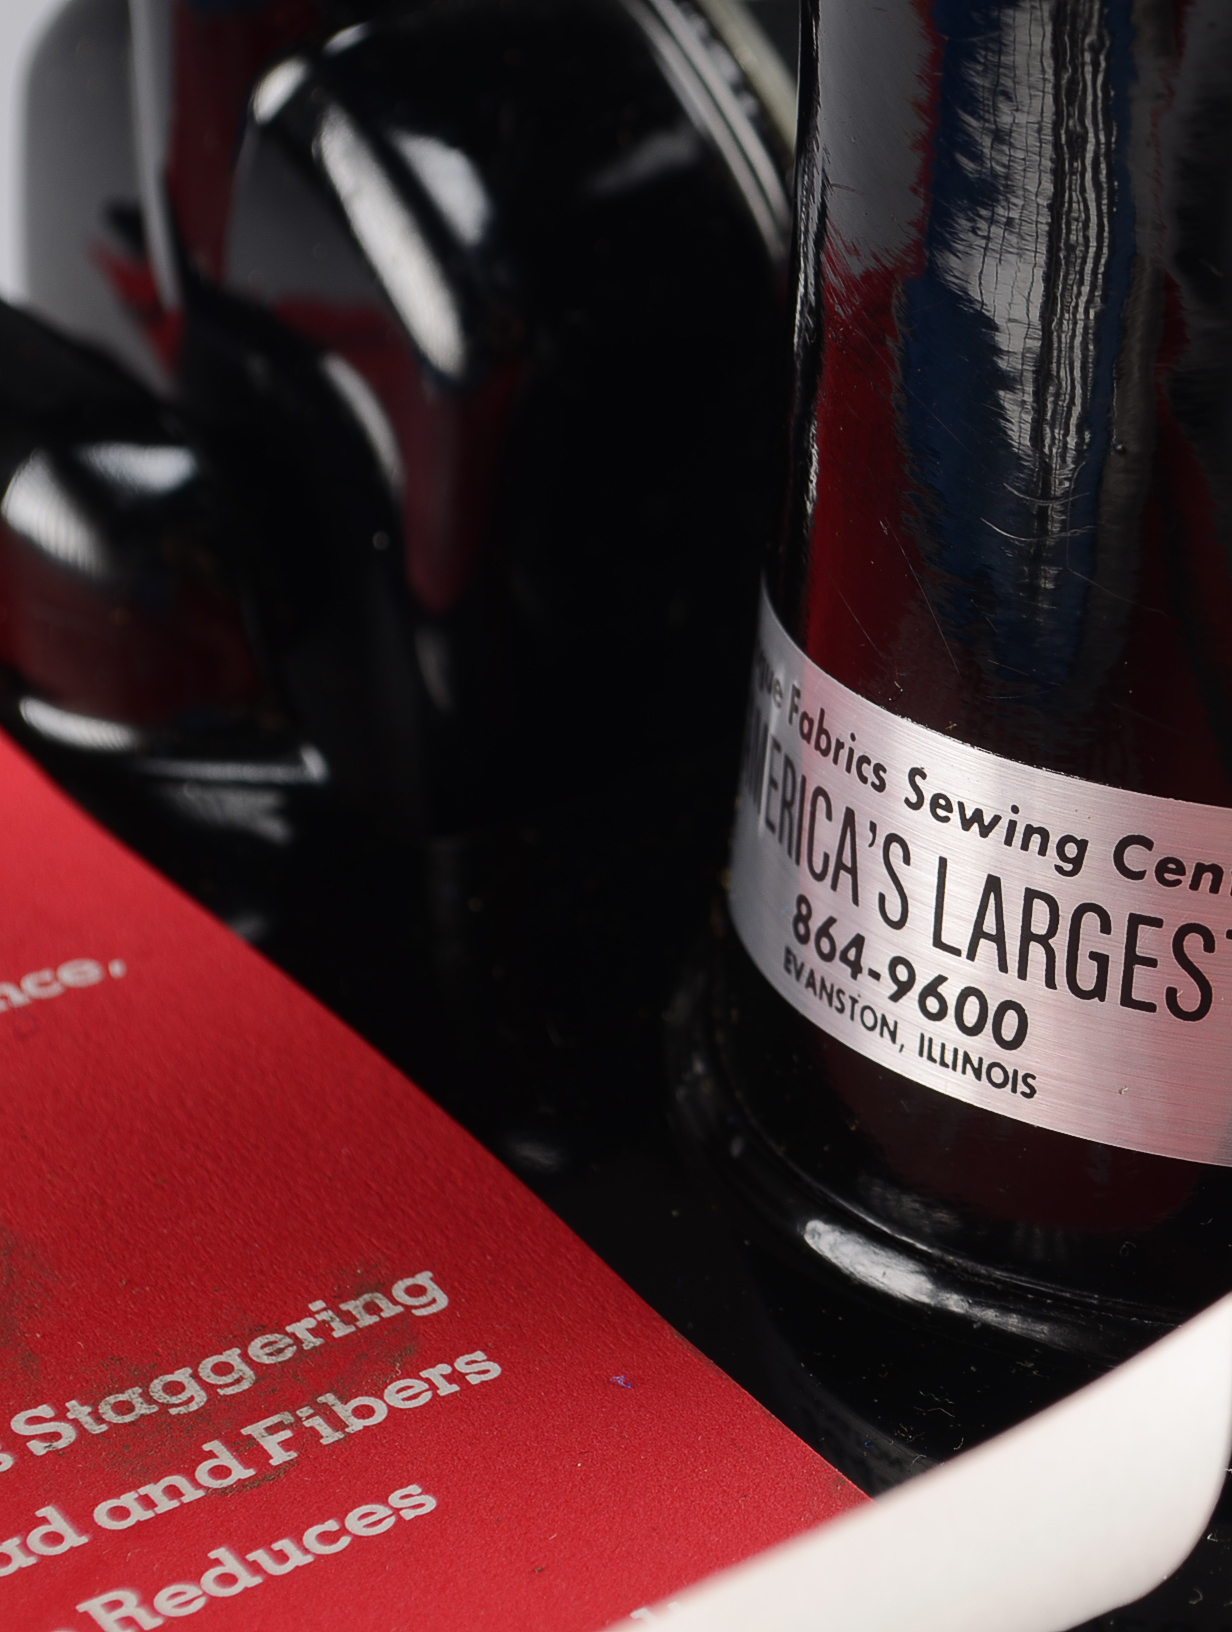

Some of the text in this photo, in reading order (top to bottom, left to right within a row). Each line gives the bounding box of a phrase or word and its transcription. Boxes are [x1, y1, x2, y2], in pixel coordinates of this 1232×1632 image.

[788, 683, 887, 793] Fabrics
[904, 767, 1088, 877] Sewing
[784, 946, 1037, 1099] EVANSTON, ILLINOIS
[792, 894, 1028, 1051] 864-9600
[10, 1270, 449, 1456] Staggering
[93, 1440, 255, 1530] and
[241, 1350, 501, 1465] Fibers
[75, 1482, 436, 1632] Reduces
